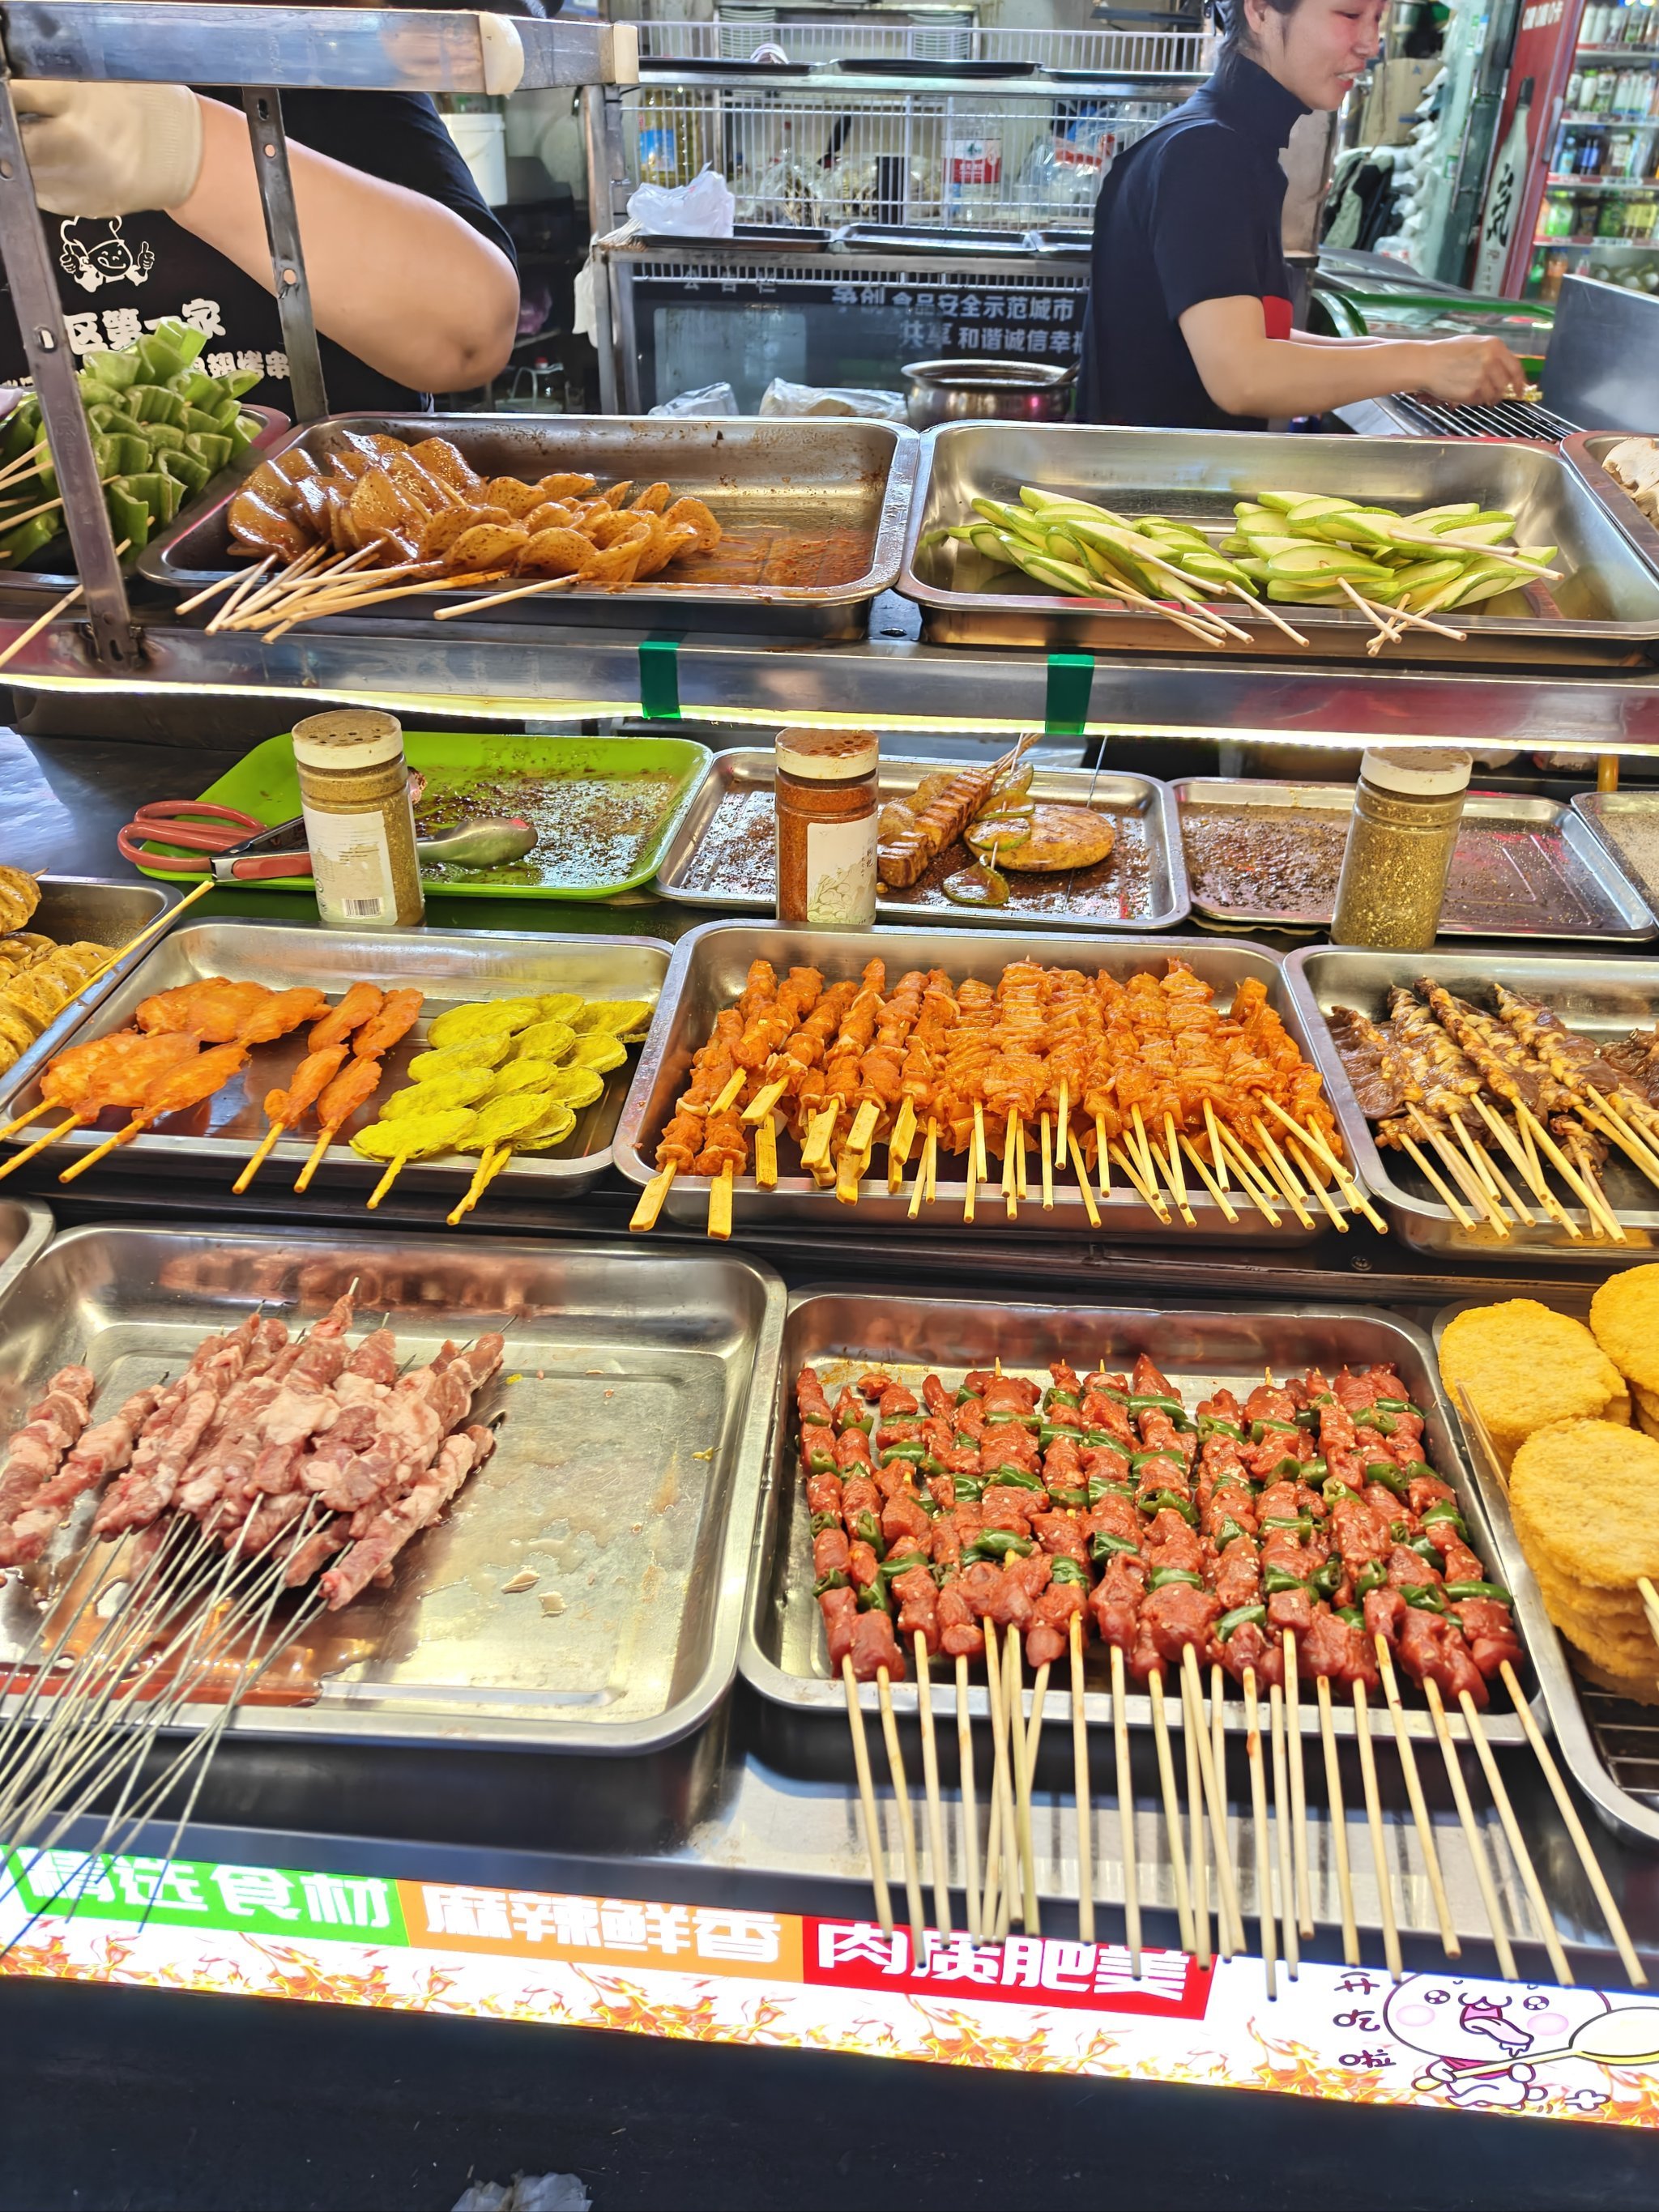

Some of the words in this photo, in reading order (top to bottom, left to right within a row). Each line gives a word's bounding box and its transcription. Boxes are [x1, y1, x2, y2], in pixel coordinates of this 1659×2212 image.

[41, 298, 226, 355] 区第一家
[16, 1848, 390, 1928] 精选食材
[421, 1885, 782, 1963] 麻辣鲜香
[817, 1922, 1191, 2001] 肉质肥美
[1333, 1971, 1397, 2068] 开吃啦
